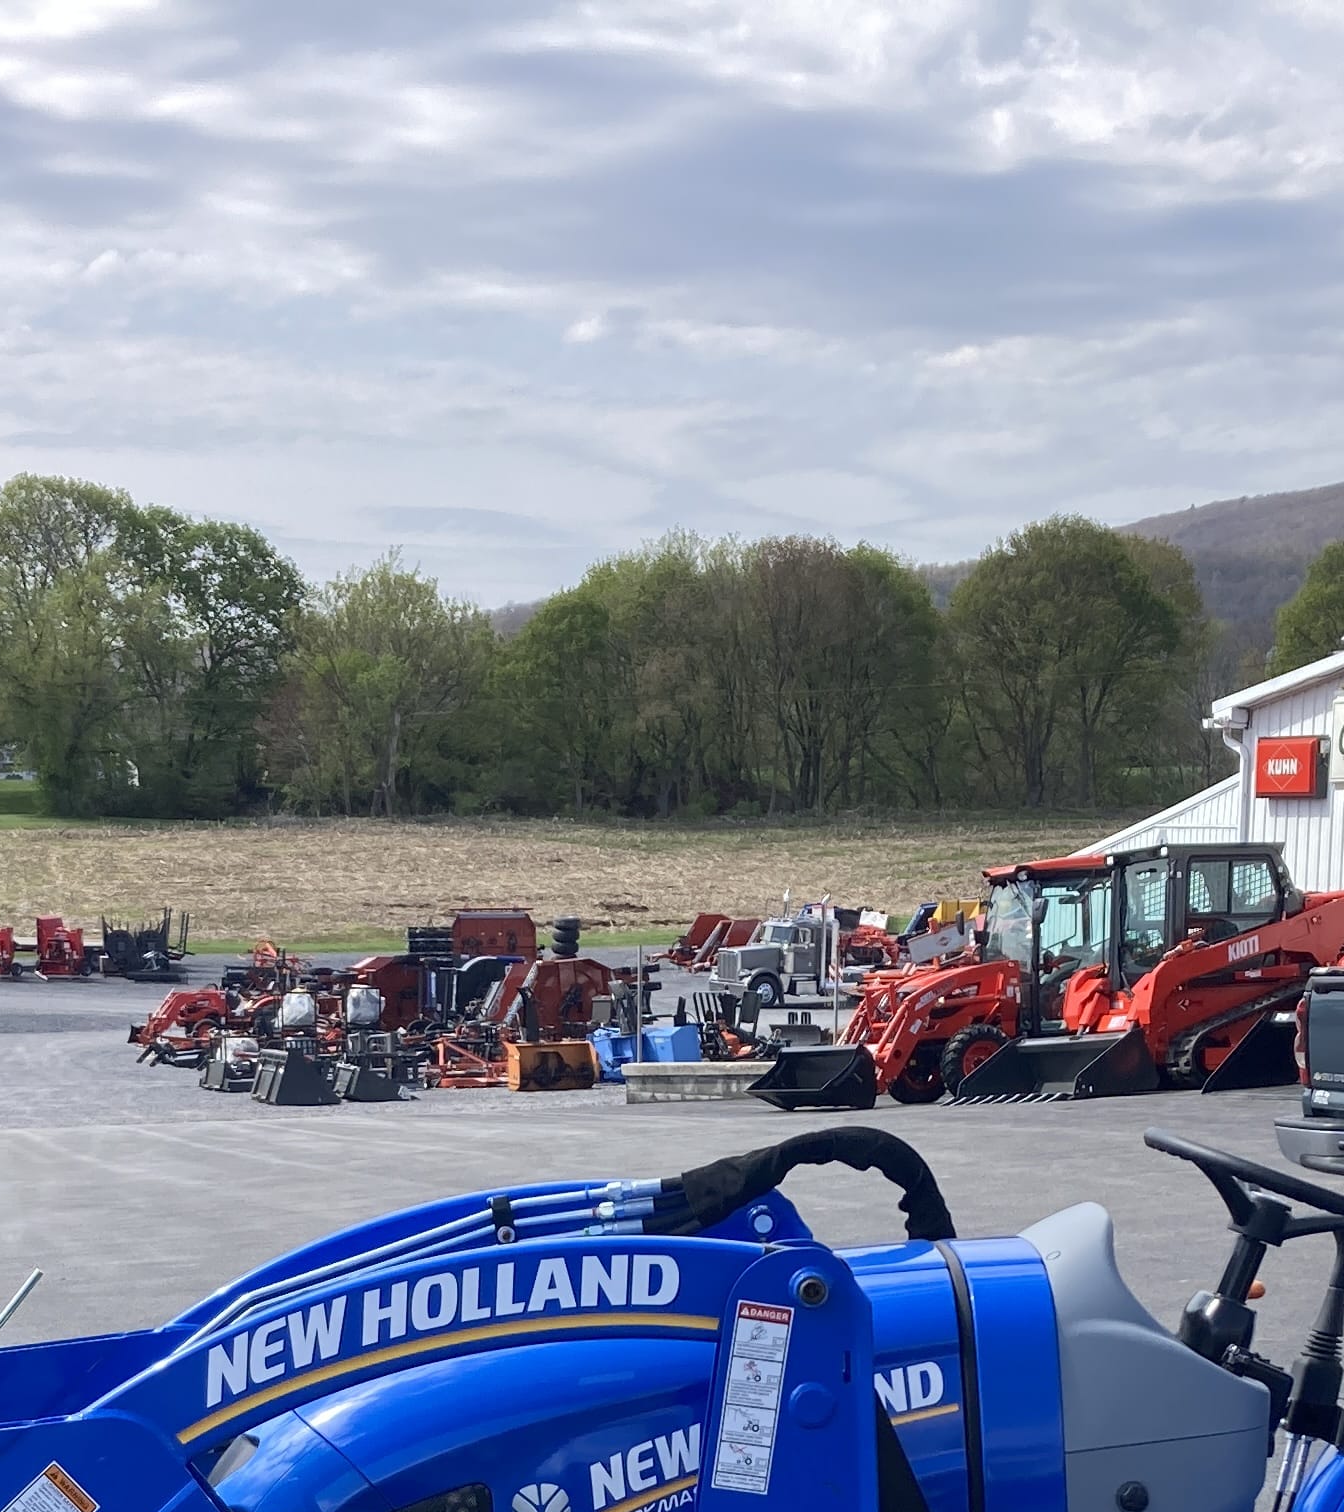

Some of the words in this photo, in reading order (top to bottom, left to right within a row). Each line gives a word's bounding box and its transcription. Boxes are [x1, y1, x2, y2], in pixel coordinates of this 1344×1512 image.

[1267, 758, 1298, 776] KUHN
[1227, 935, 1260, 962] KIOTI
[750, 1308, 789, 1320] DANGER
[205, 1295, 347, 1409] NEW
[361, 1253, 681, 1347] HOLLAND
[590, 1422, 701, 1510] NEW
